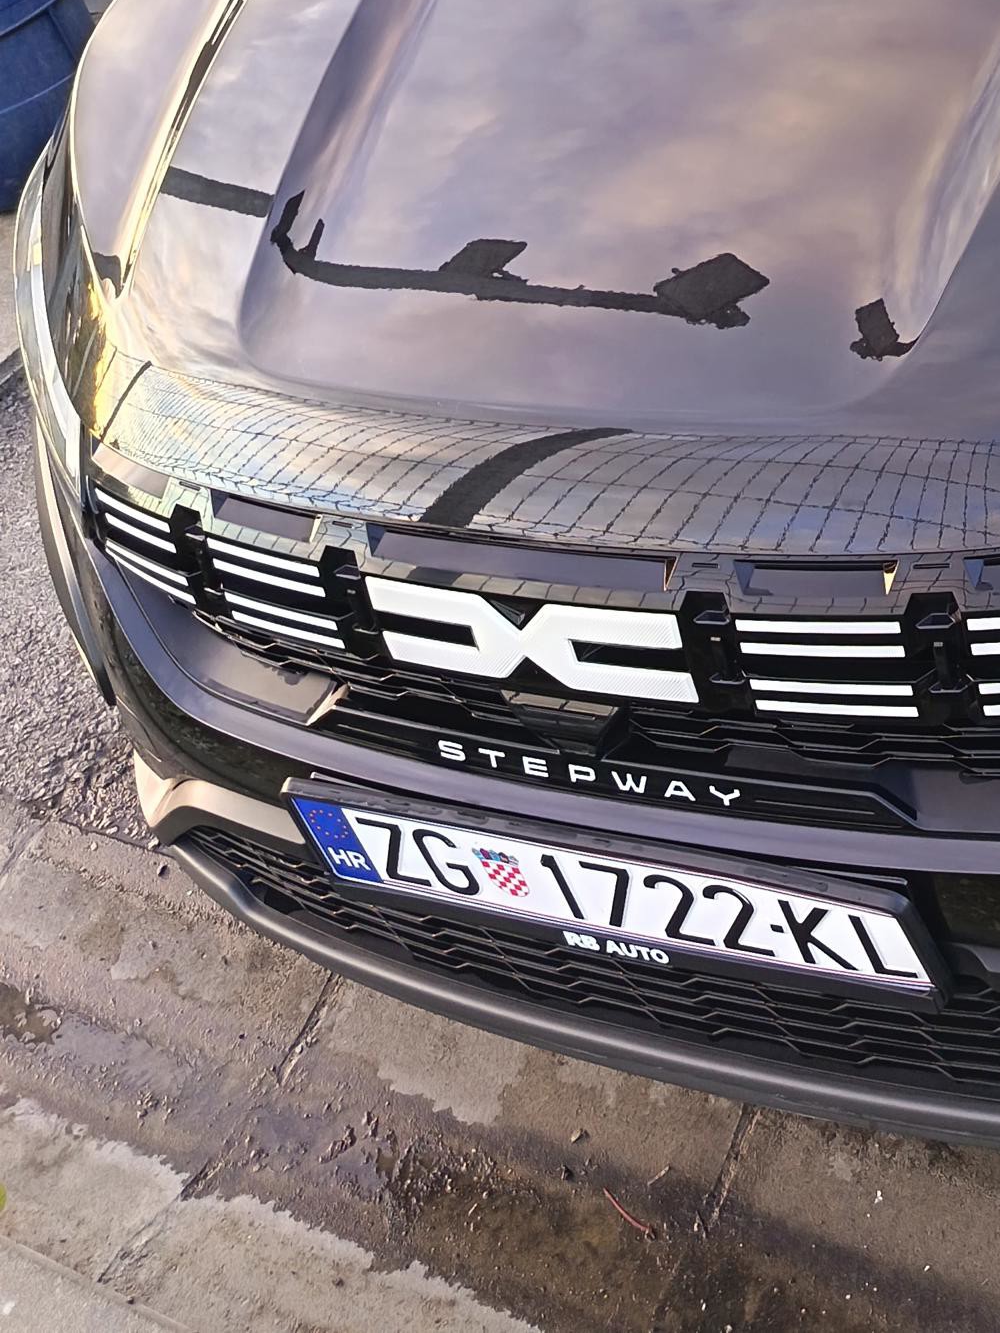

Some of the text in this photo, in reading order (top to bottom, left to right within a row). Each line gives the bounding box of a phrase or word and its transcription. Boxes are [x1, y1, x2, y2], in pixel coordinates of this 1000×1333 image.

[437, 739, 741, 806] STEPWAY
[327, 846, 371, 871] HR
[355, 817, 919, 979] ZG 1722-KL
[562, 930, 670, 965] RB AUTO
